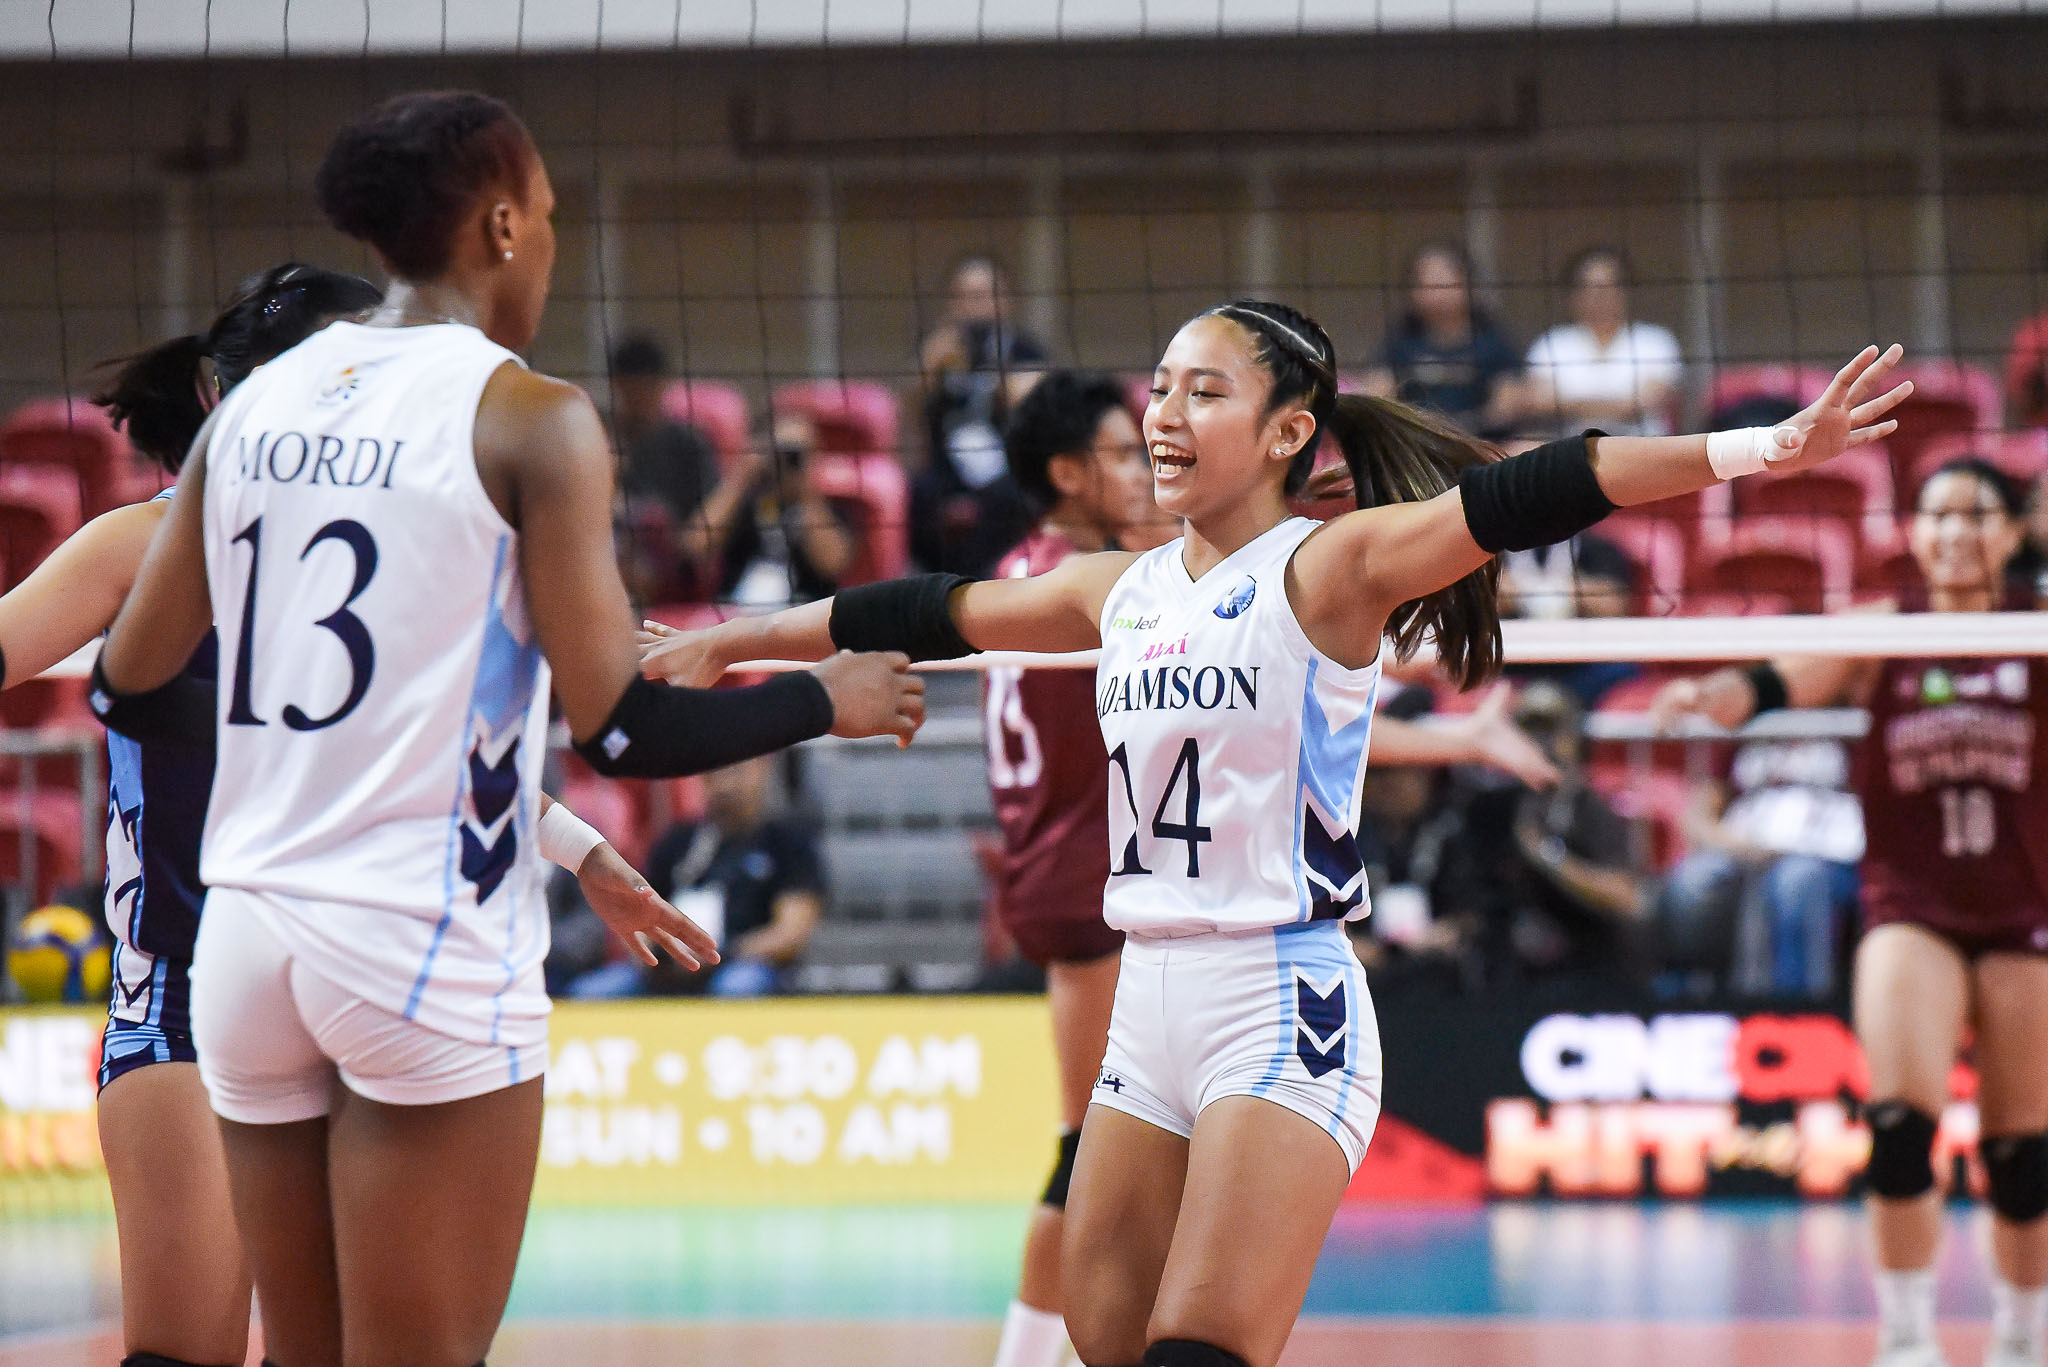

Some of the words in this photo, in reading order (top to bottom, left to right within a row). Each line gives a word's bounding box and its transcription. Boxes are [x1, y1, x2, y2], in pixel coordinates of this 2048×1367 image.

[227, 515, 379, 731] 13
[1112, 614, 1161, 630] nxled
[1109, 737, 1212, 878] 14
[547, 1037, 640, 1100] AT
[704, 1035, 857, 1100] 9:30
[868, 1035, 983, 1100] AM
[745, 1104, 826, 1167] 10
[840, 1104, 952, 1167] AM
[1487, 1100, 1735, 1197] HIT
